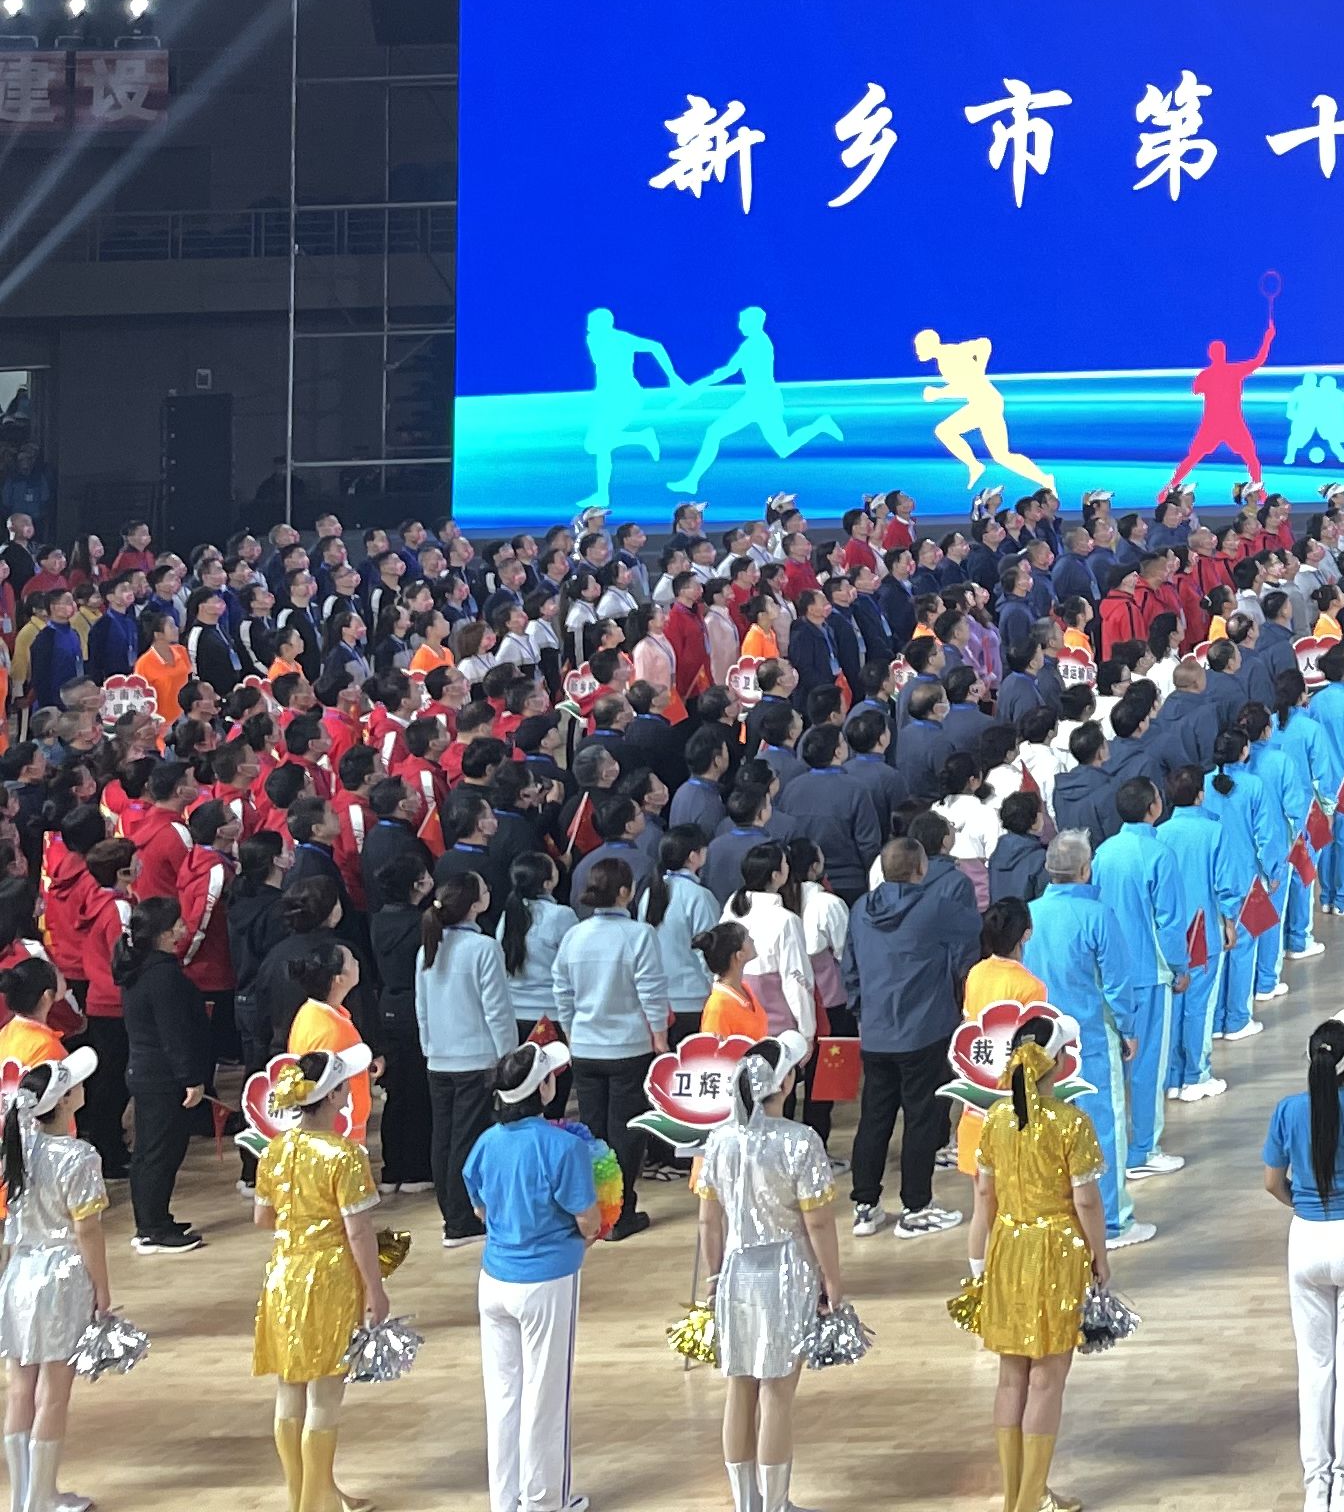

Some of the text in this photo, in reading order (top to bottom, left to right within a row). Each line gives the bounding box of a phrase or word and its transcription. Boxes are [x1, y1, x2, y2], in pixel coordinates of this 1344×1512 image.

[0, 56, 157, 123] 建设
[973, 1039, 1011, 1065] 裁
[672, 1072, 736, 1099] 卫辉
